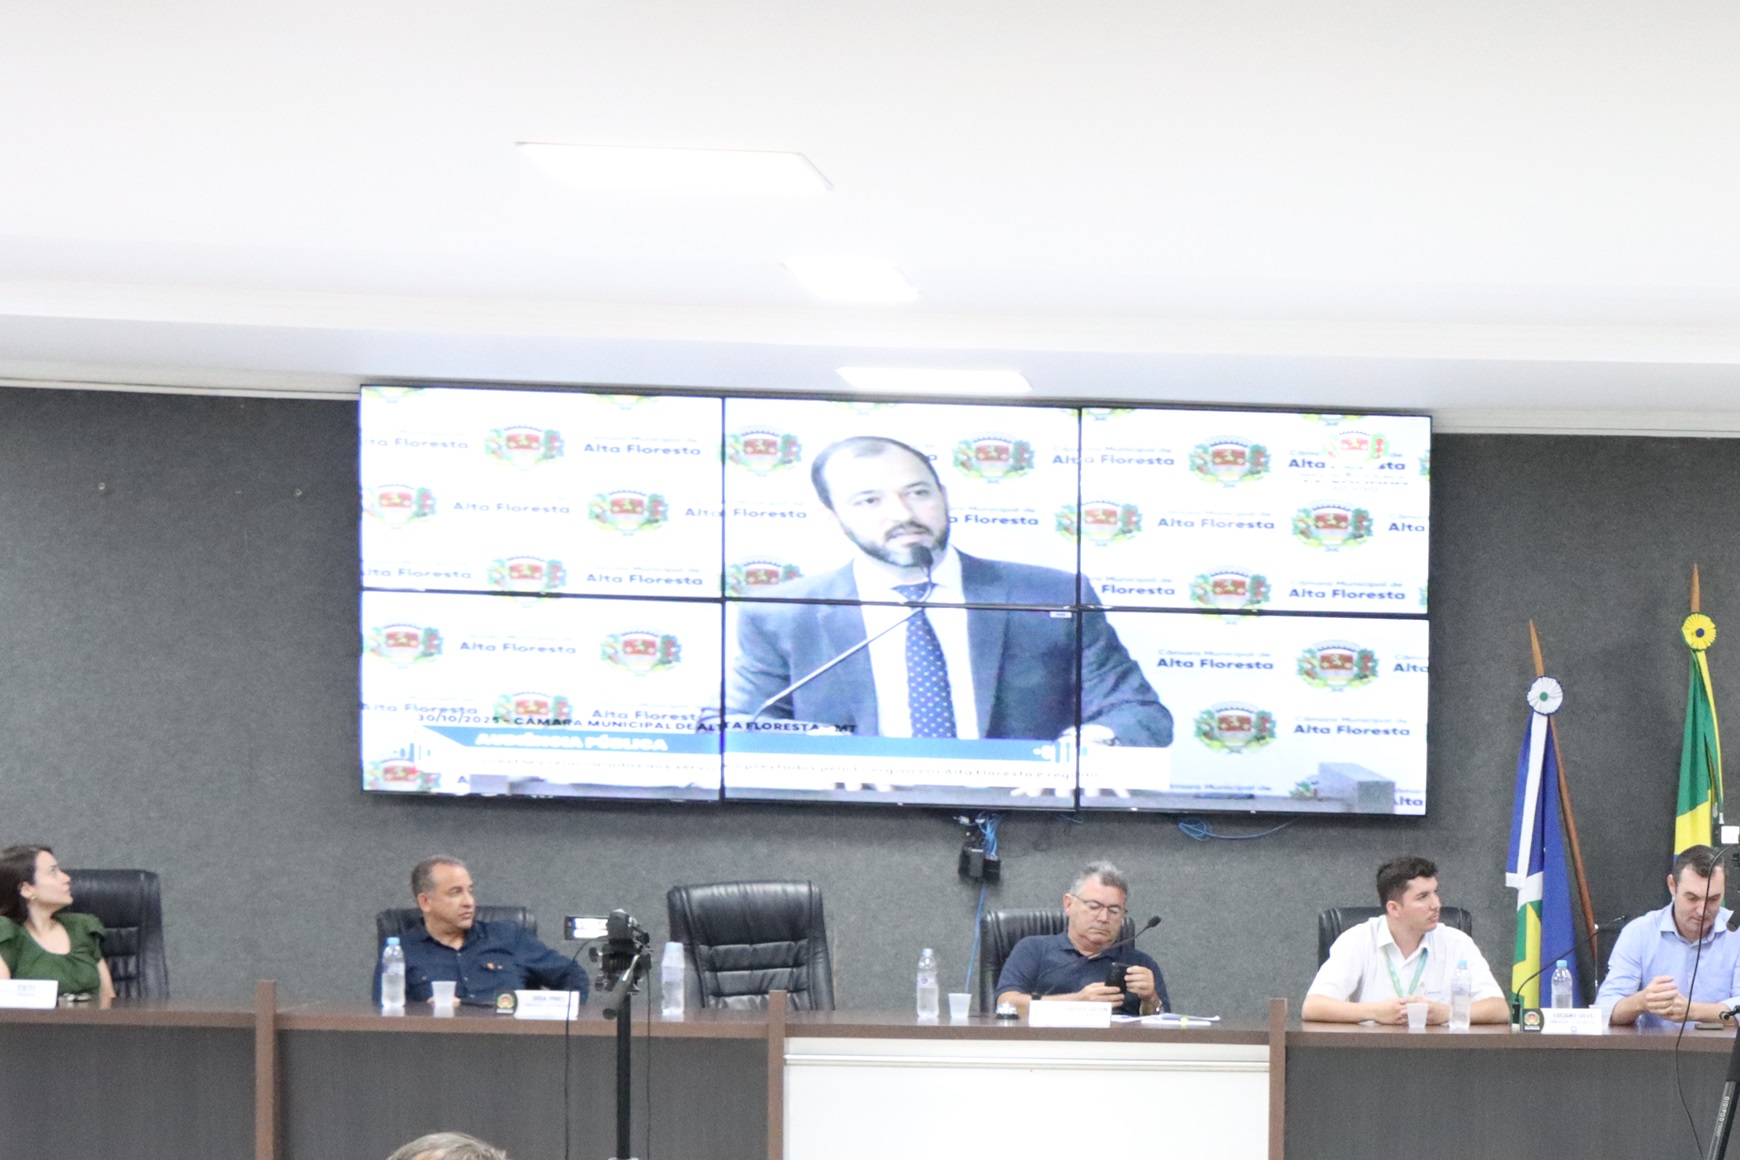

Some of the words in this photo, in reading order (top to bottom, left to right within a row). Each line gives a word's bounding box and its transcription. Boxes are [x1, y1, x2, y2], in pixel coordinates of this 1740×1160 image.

[584, 444, 620, 453] Alta
[627, 444, 701, 456] Floresta
[1052, 455, 1094, 465] Alta
[1101, 455, 1175, 466] Floresta
[1288, 459, 1325, 470] Alta
[454, 502, 489, 511] Alta
[497, 503, 570, 514] Floresta
[734, 509, 807, 519] Floresta
[964, 515, 1039, 526] Floresta
[1158, 518, 1195, 528] Alta
[1201, 518, 1275, 529] Floresta
[1388, 522, 1425, 532] Alta
[586, 573, 622, 583] Alta
[629, 574, 703, 585] Floresta
[1101, 584, 1176, 596] Floresta
[1288, 589, 1326, 599] Alta
[1332, 589, 1406, 600] Floresta
[460, 642, 496, 651] Alta
[503, 643, 576, 654] Floresta
[1157, 658, 1194, 668] Alta
[1200, 658, 1274, 670] Floresta
[592, 709, 628, 719] Alta
[515, 715, 582, 727] CÂMARA
[587, 719, 673, 731] MUNICIPAL
[675, 721, 694, 730] DE
[745, 721, 819, 732] FLORESTA
[1294, 724, 1331, 735] Alta
[1336, 725, 1411, 736] Floresta
